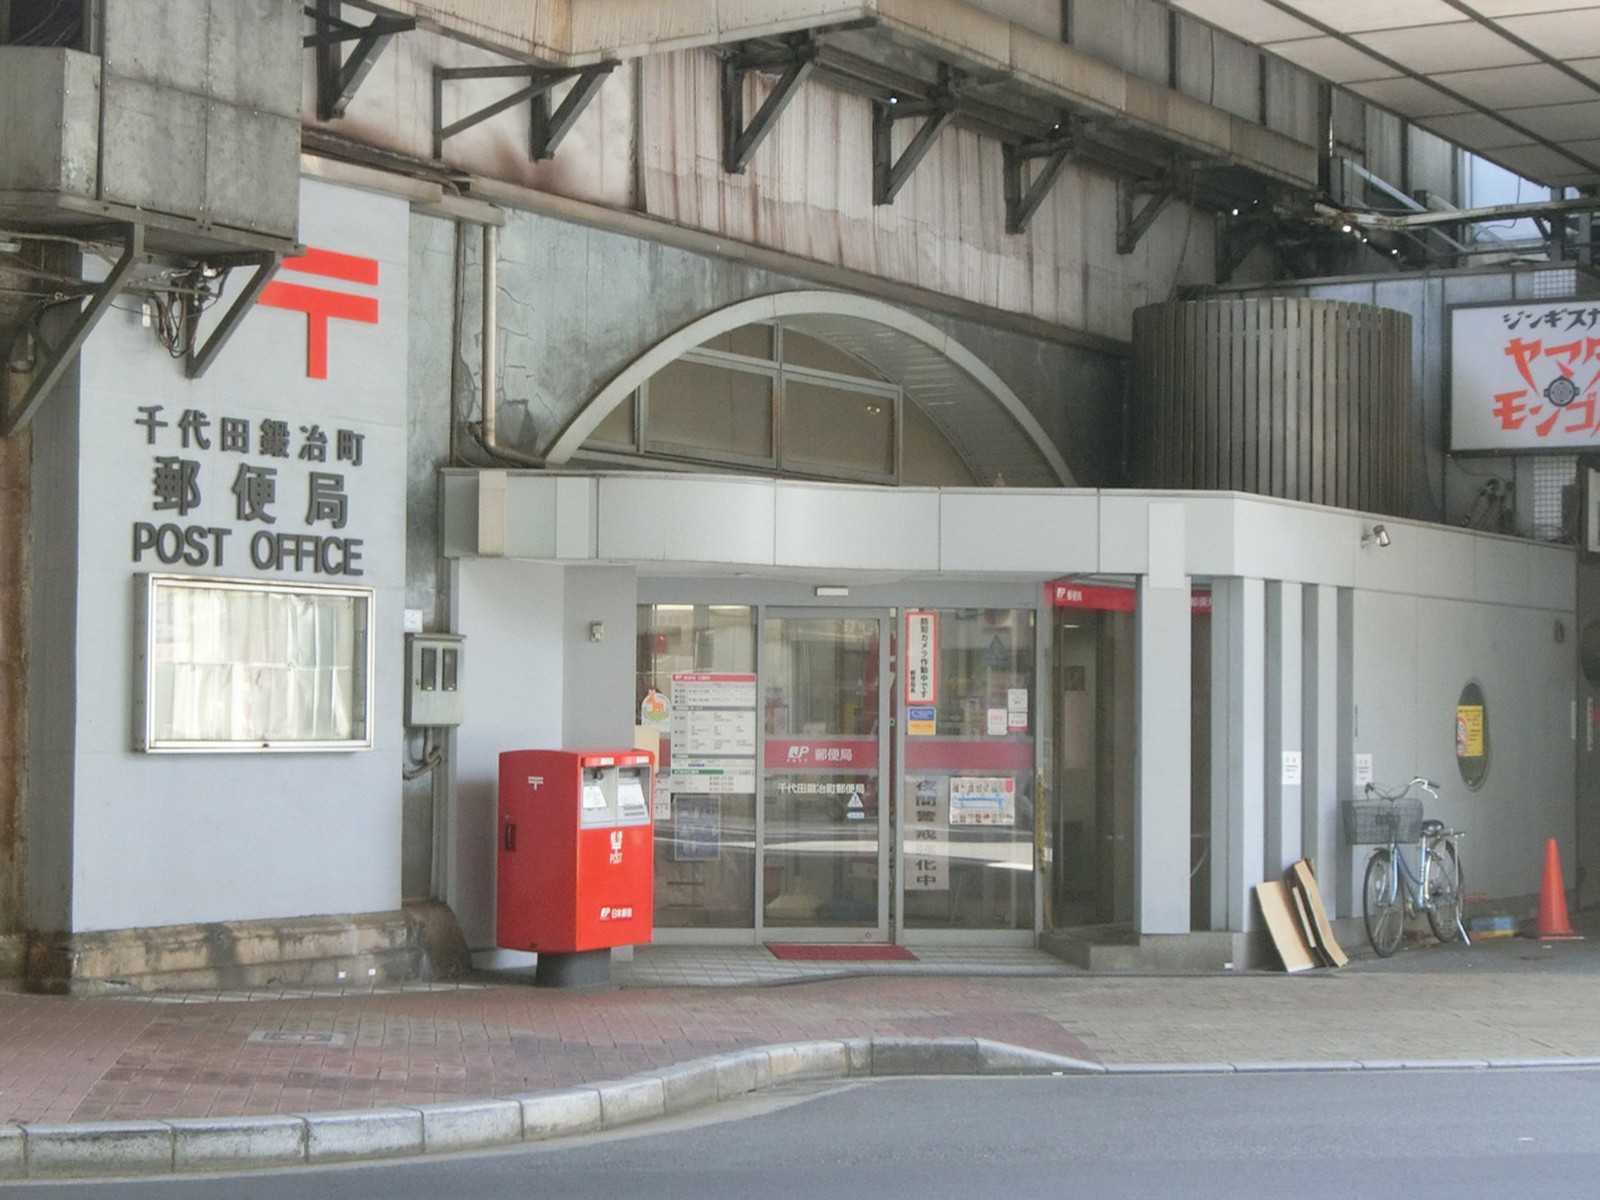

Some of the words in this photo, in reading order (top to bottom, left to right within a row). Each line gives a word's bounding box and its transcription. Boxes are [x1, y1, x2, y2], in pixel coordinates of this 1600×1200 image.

[135, 405, 365, 466] 千代田鍛冶町
[153, 456, 348, 528] 郵便局
[133, 522, 232, 566] POST
[251, 530, 364, 575] OFFICE
[815, 748, 852, 761] 郵便局
